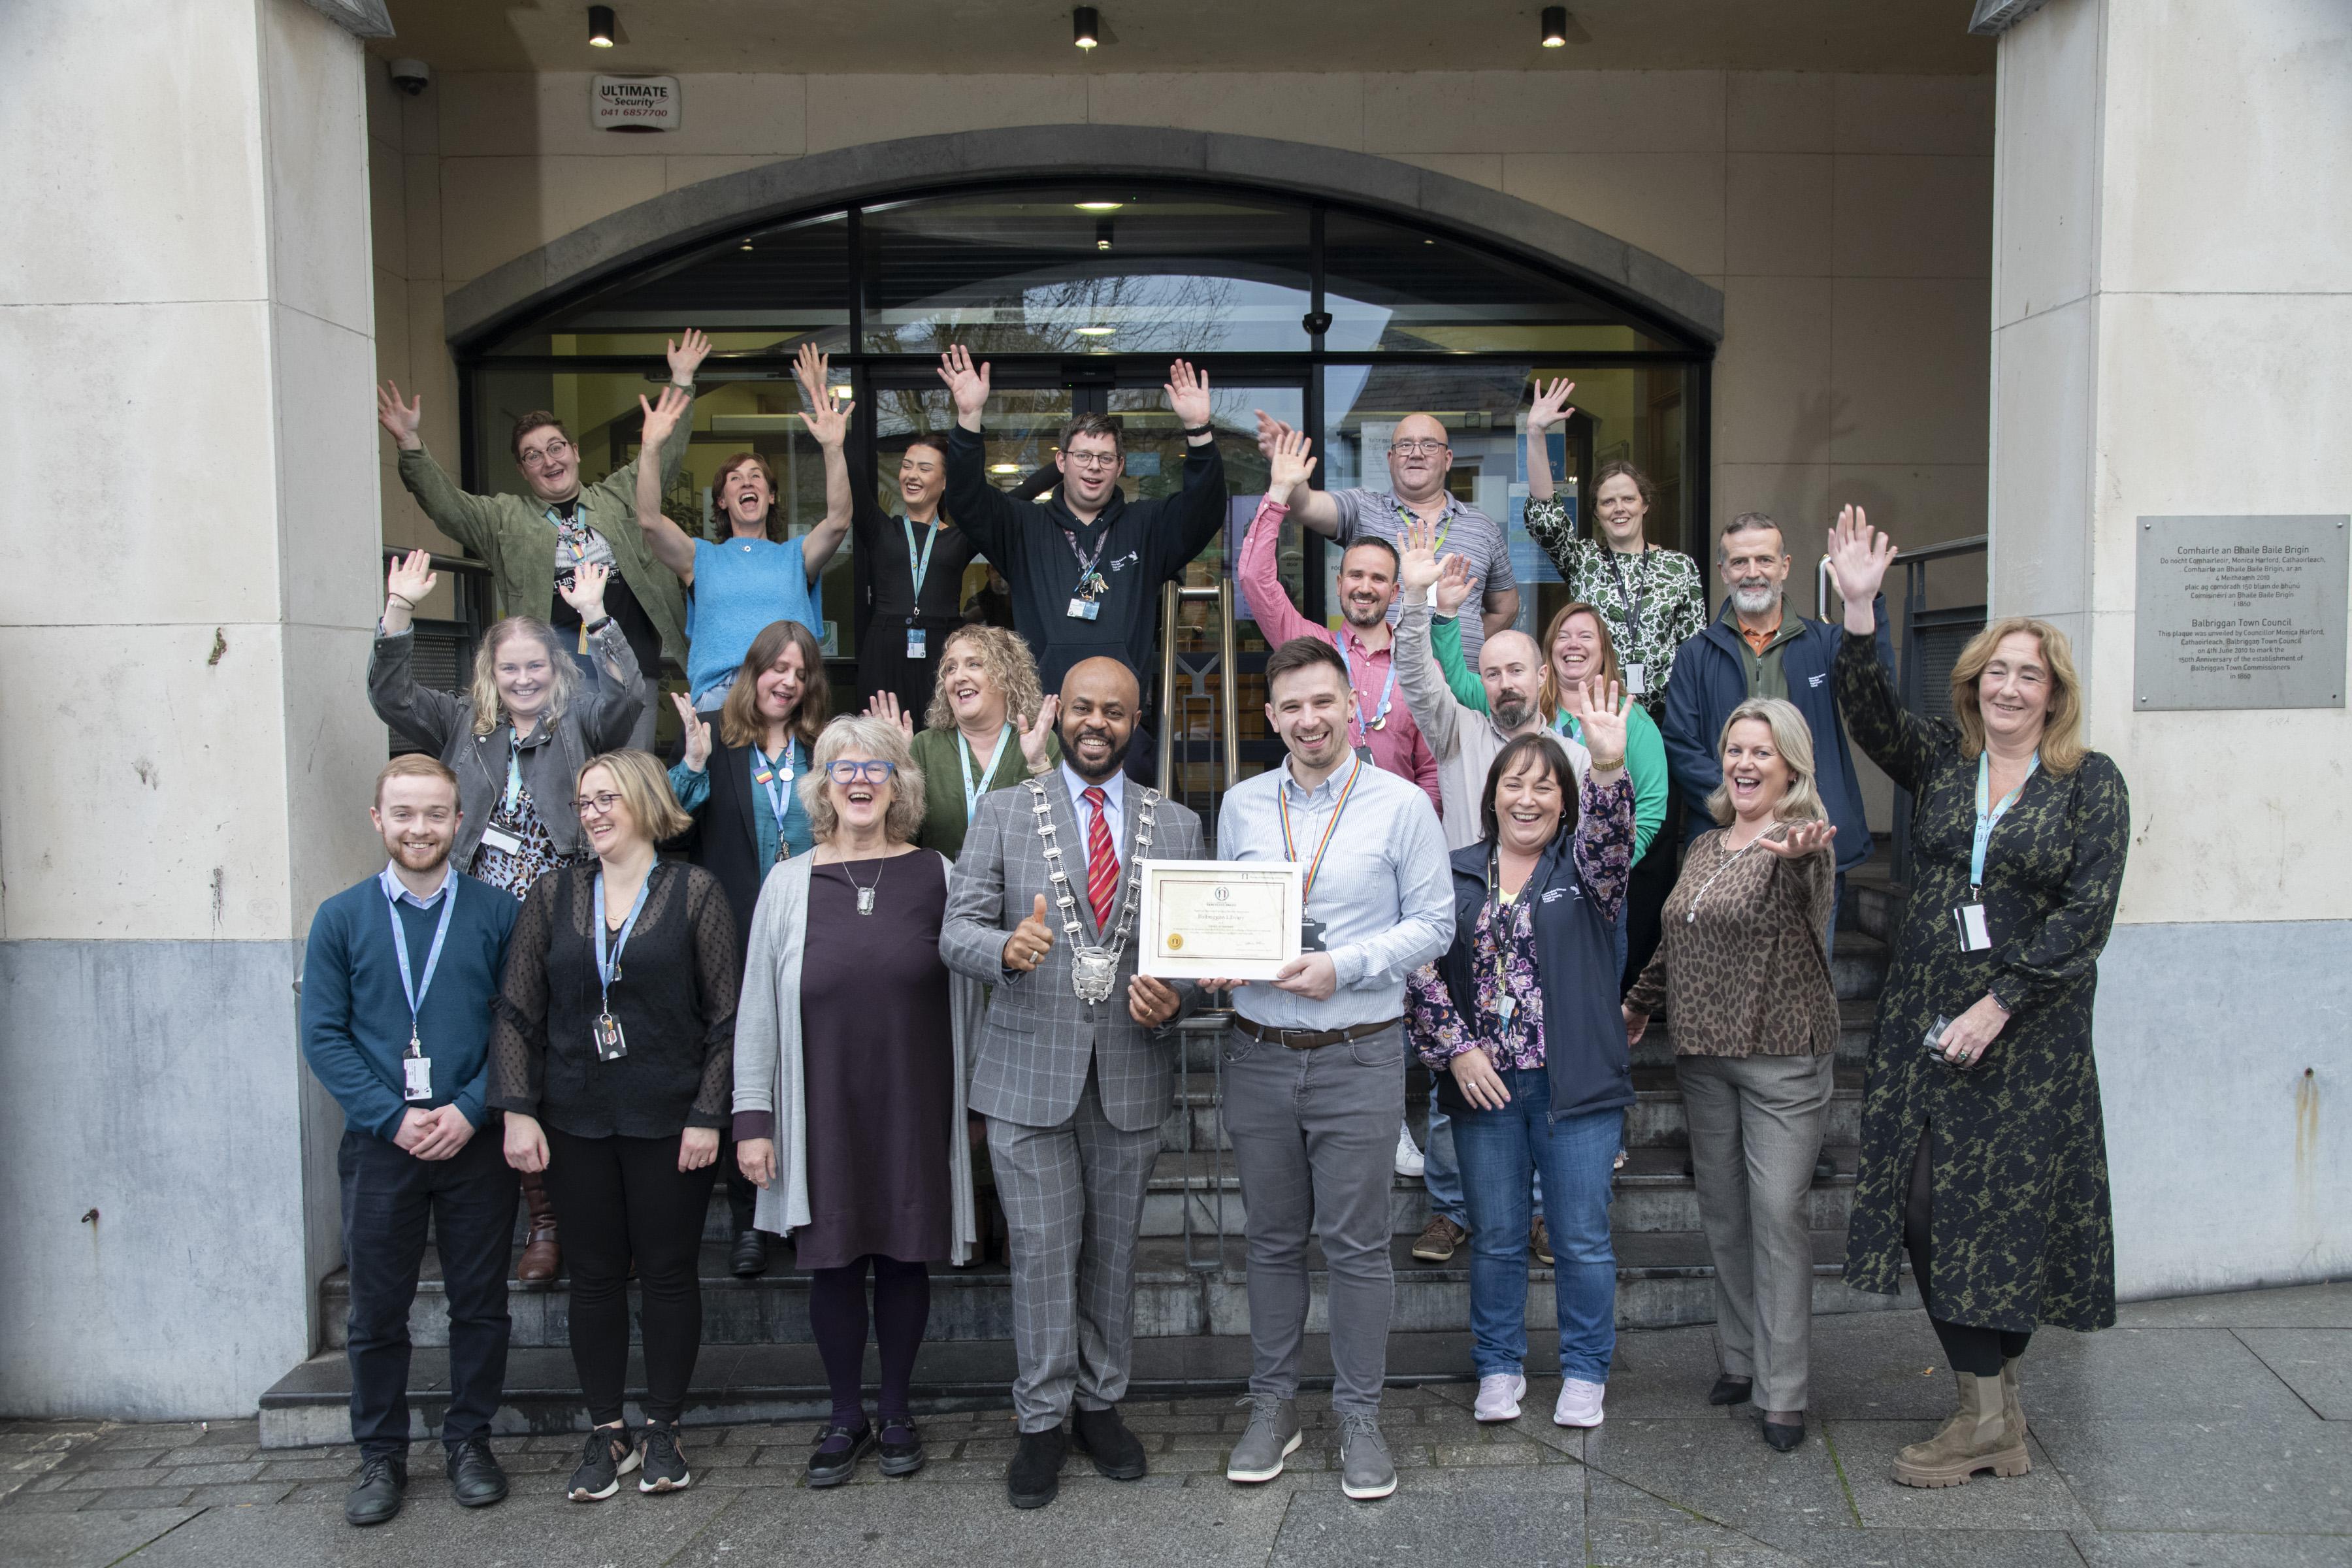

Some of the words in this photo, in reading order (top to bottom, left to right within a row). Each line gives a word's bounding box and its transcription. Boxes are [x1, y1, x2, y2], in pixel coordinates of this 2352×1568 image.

[602, 86, 668, 97] ULTIMATE
[615, 97, 655, 108] Security
[2192, 619, 2236, 629] Balbriggan
